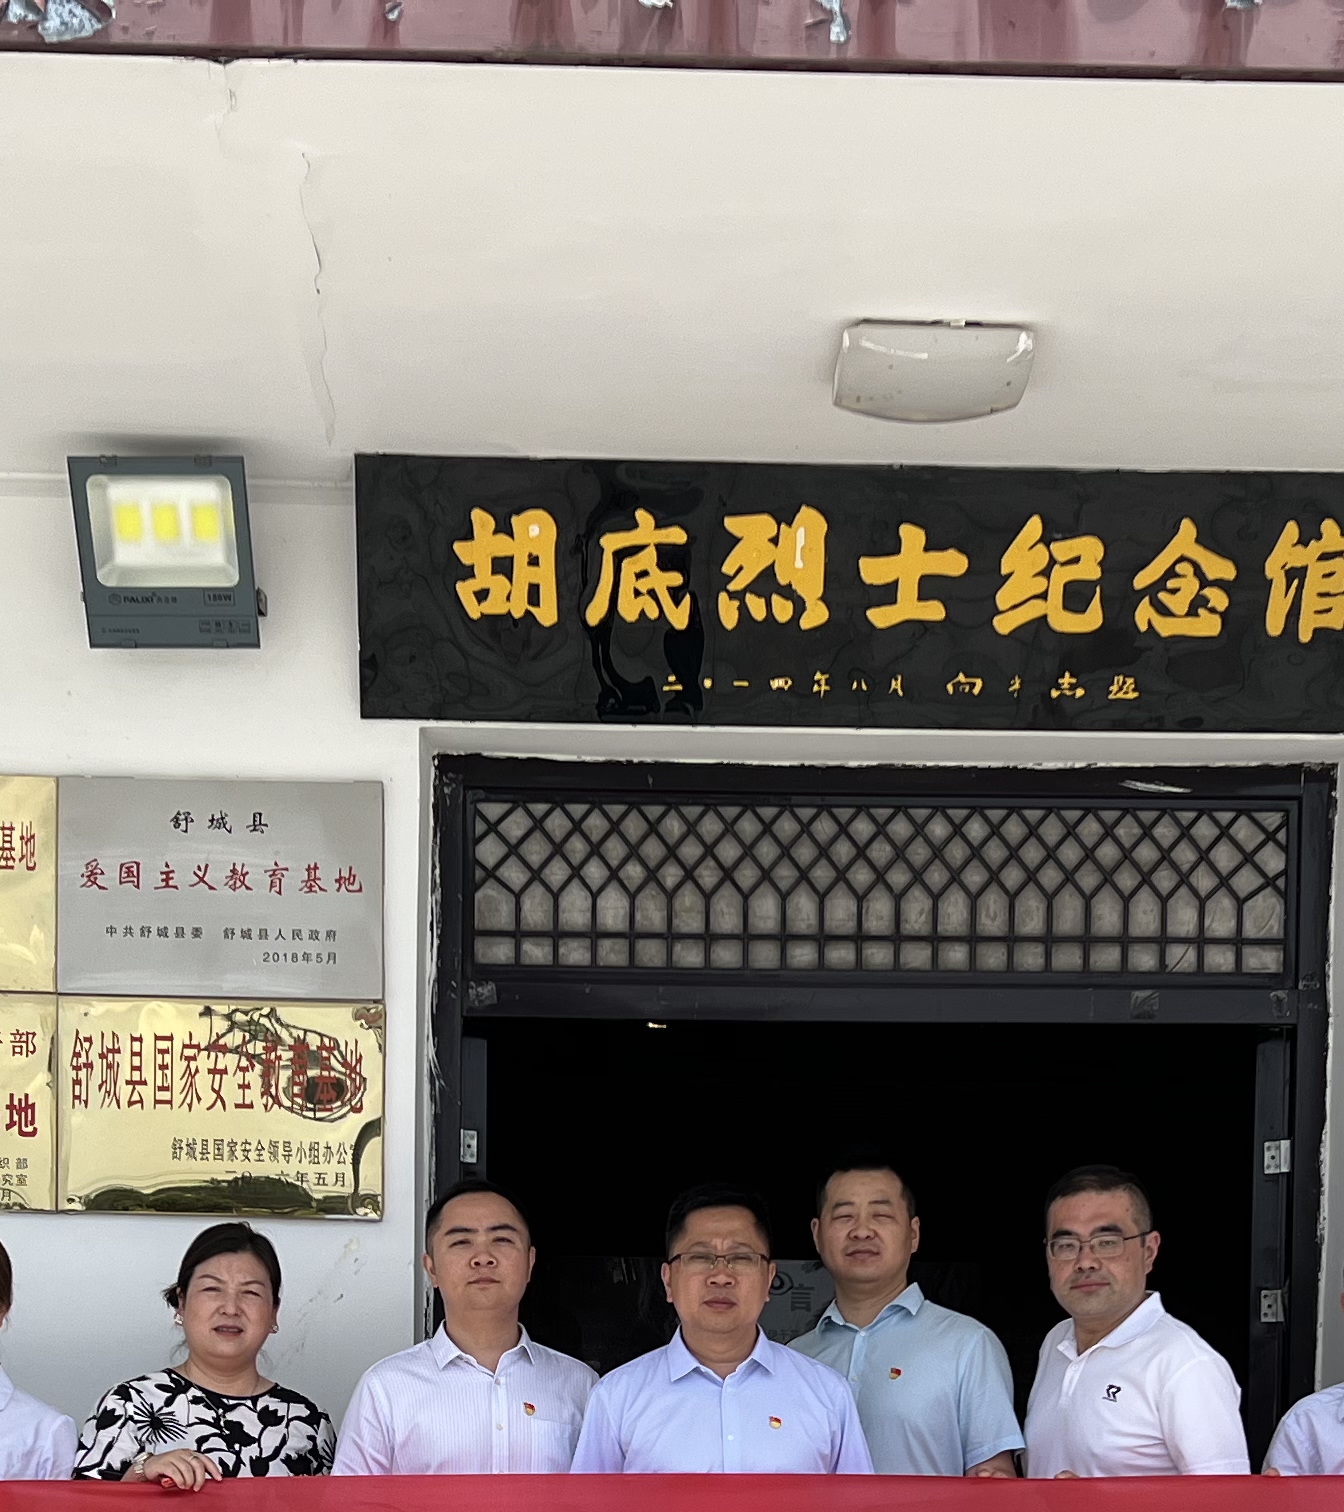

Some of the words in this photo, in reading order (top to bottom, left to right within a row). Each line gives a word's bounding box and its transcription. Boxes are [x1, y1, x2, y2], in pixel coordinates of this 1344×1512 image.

[169, 810, 269, 834] 舒城县
[79, 858, 363, 896] 爱国主义教育基地
[106, 925, 203, 940] 中共舒城县委
[223, 927, 337, 942] 舒城县人民政府
[262, 951, 338, 965] 2018年5月
[69, 1028, 365, 1114] 舒城县国家安全教育基地
